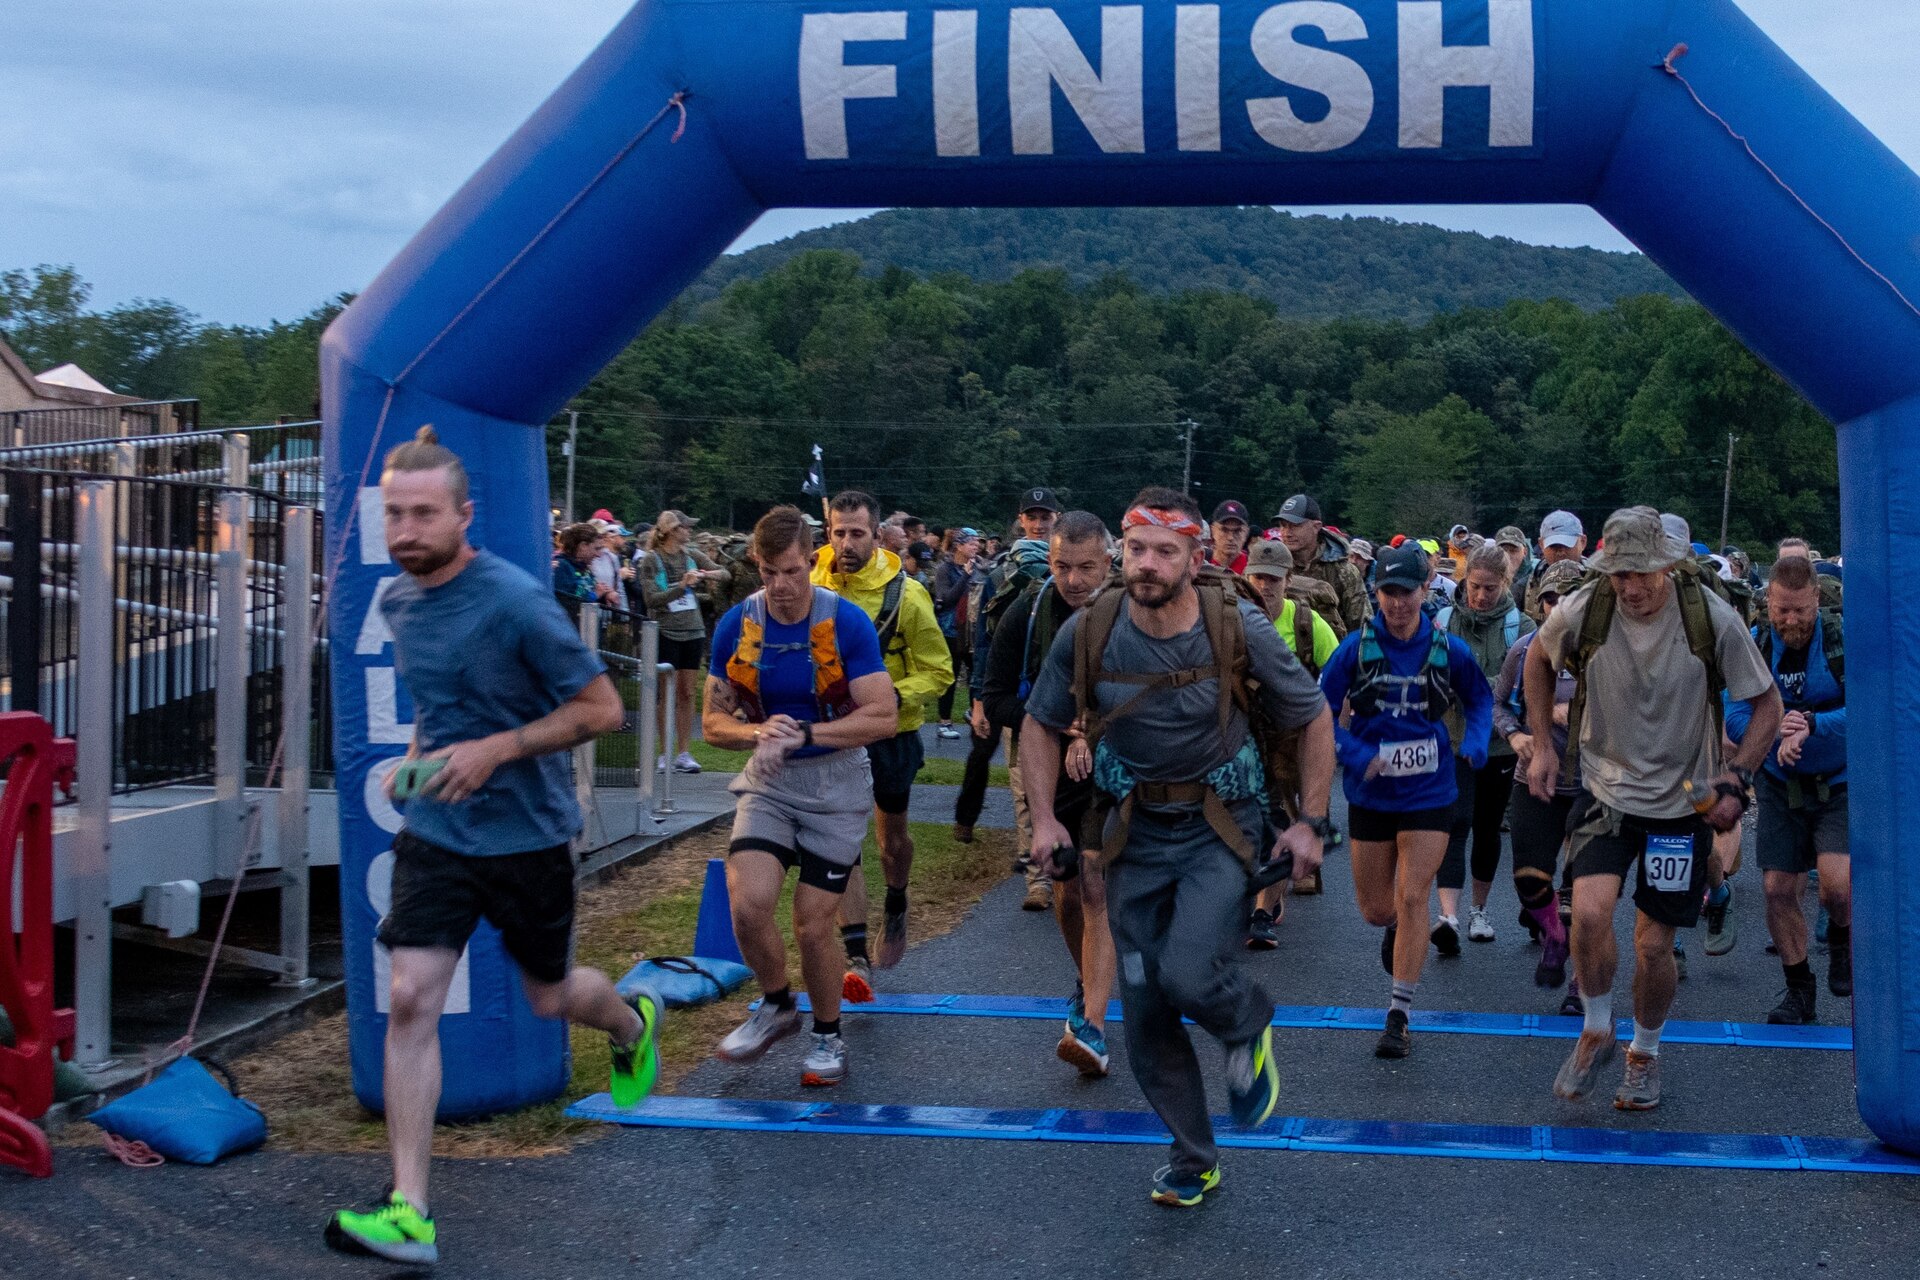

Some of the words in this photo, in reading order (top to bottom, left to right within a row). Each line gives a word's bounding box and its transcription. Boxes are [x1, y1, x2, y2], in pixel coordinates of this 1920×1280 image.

[800, 0, 1535, 160] FINISH
[1392, 745, 1427, 770] 436
[1650, 856, 1690, 881] 307
